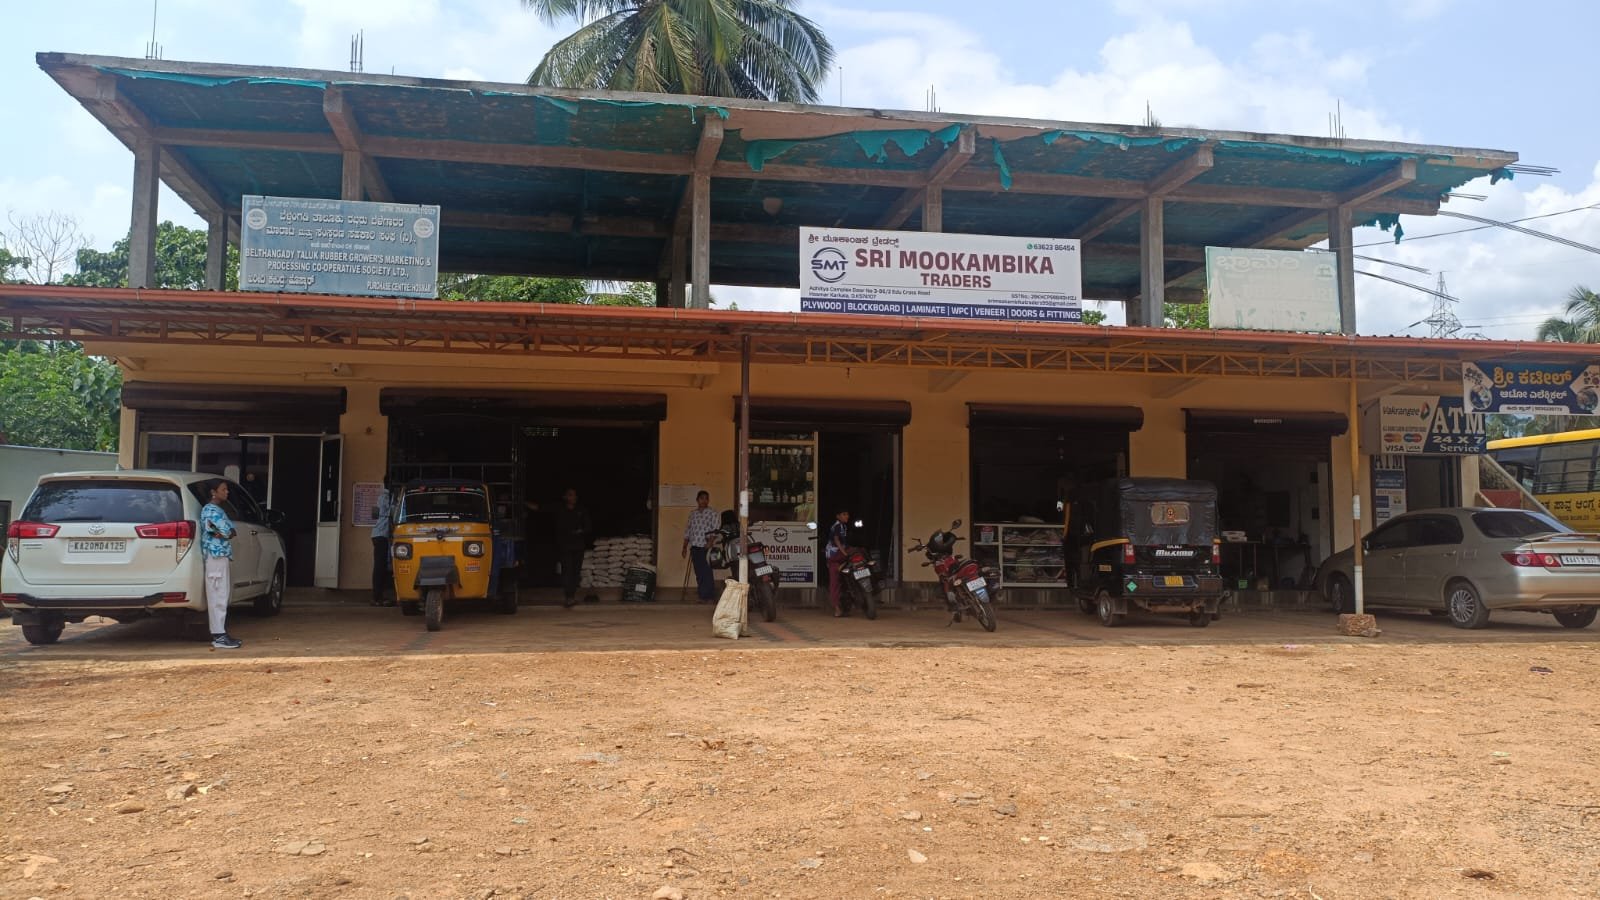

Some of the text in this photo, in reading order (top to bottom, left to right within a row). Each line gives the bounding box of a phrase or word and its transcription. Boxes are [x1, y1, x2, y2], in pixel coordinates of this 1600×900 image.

[808, 233, 819, 243] ಶ್ರೀ
[245, 248, 431, 266] BELTHANGADY TALUK RUBBER GROWER'S MARKETING &
[855, 248, 1055, 275] SRI MOOKAMBIKA
[267, 261, 311, 271] PROCESSING
[312, 262, 361, 274] CO-OPERATIVE
[362, 265, 391, 276] SOCIETY
[811, 259, 848, 271] SMT
[920, 273, 992, 289] TRADERS
[802, 300, 1081, 319] PLYWOOD BLOCKBOARD LAMINATE WPC VENEER DOORS & FITTINGS
[1494, 367, 1573, 388] ಶ್ರೀ ಕಟೀಲ್
[1383, 406, 1420, 416] Vakrangee
[1432, 407, 1486, 434] ATM
[1432, 435, 1452, 444] 24
[1474, 436, 1484, 444] 7
[1440, 444, 1480, 452] Service
